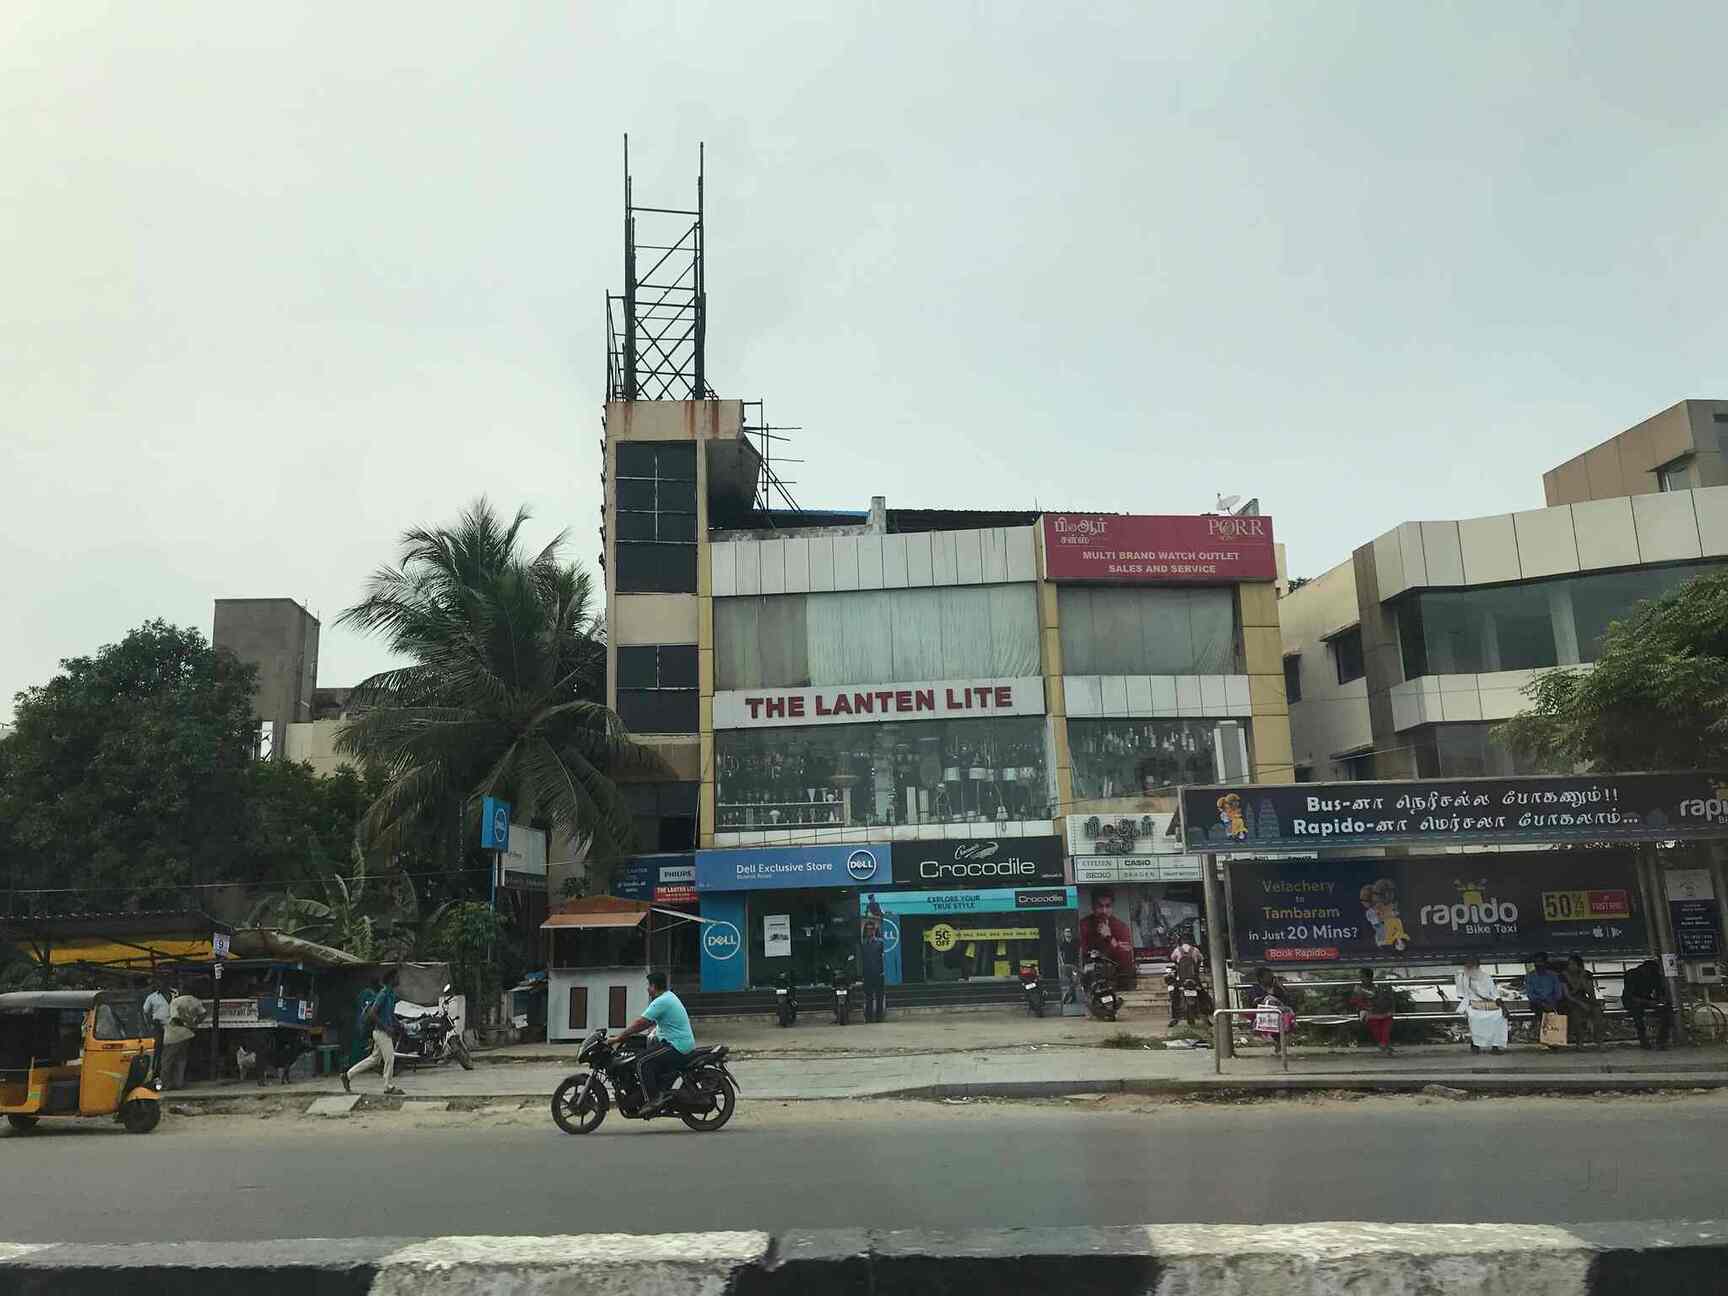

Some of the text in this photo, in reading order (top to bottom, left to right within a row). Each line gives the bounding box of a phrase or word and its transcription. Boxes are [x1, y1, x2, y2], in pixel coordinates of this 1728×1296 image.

[1083, 551, 1240, 561] MULTI BRAND WATCH OUTLET
[1109, 564, 1217, 573] SALES AND SERVICE
[745, 686, 1013, 719] THE LANTEN LITE
[1306, 797, 1384, 812] Bus-னா
[1396, 790, 1490, 815] நெரிசல்ல
[1293, 817, 1408, 836] Rapido-னா
[1419, 813, 1507, 832] மெர்சலா
[736, 861, 833, 874] Dell Exclusive Store
[850, 860, 873, 869] DELL
[920, 857, 1036, 878] Crocodile
[1262, 880, 1335, 894] Velachery
[959, 895, 981, 903] YOUR
[1018, 894, 1064, 904] Crocodile
[1296, 895, 1305, 903] to
[933, 902, 976, 911] TRUE STYLE
[1261, 905, 1340, 920] Tambaram
[1420, 897, 1518, 931] rapido
[1248, 925, 1360, 941] in Just 20 Mins?
[1466, 924, 1518, 934] Bike Taxi
[708, 935, 737, 946] DELL
[1269, 948, 1294, 958] Book
